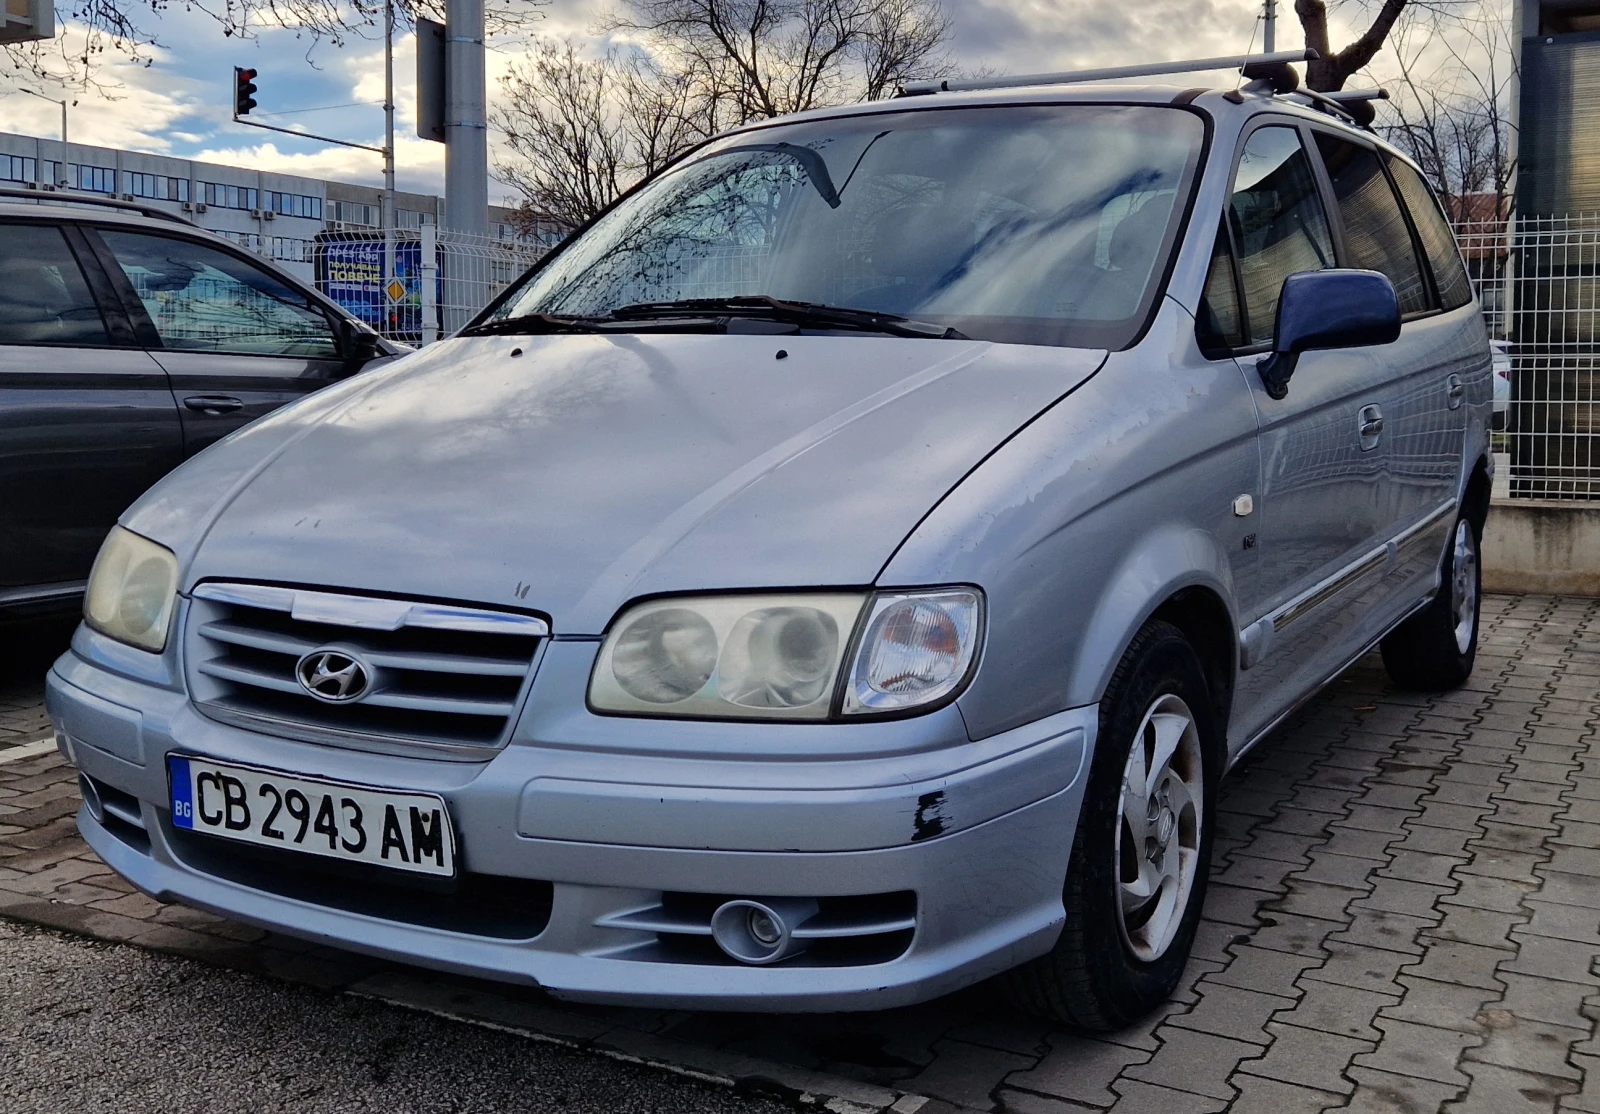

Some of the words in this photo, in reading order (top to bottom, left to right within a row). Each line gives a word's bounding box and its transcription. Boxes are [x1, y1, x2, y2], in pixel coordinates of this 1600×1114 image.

[329, 261, 380, 271] ПОЛУЧАВАШ
[329, 270, 380, 283] ПОВЕЧЕ
[175, 800, 191, 818] BG
[197, 771, 251, 831] CB
[259, 783, 367, 854] 2943
[381, 804, 444, 867] AM
